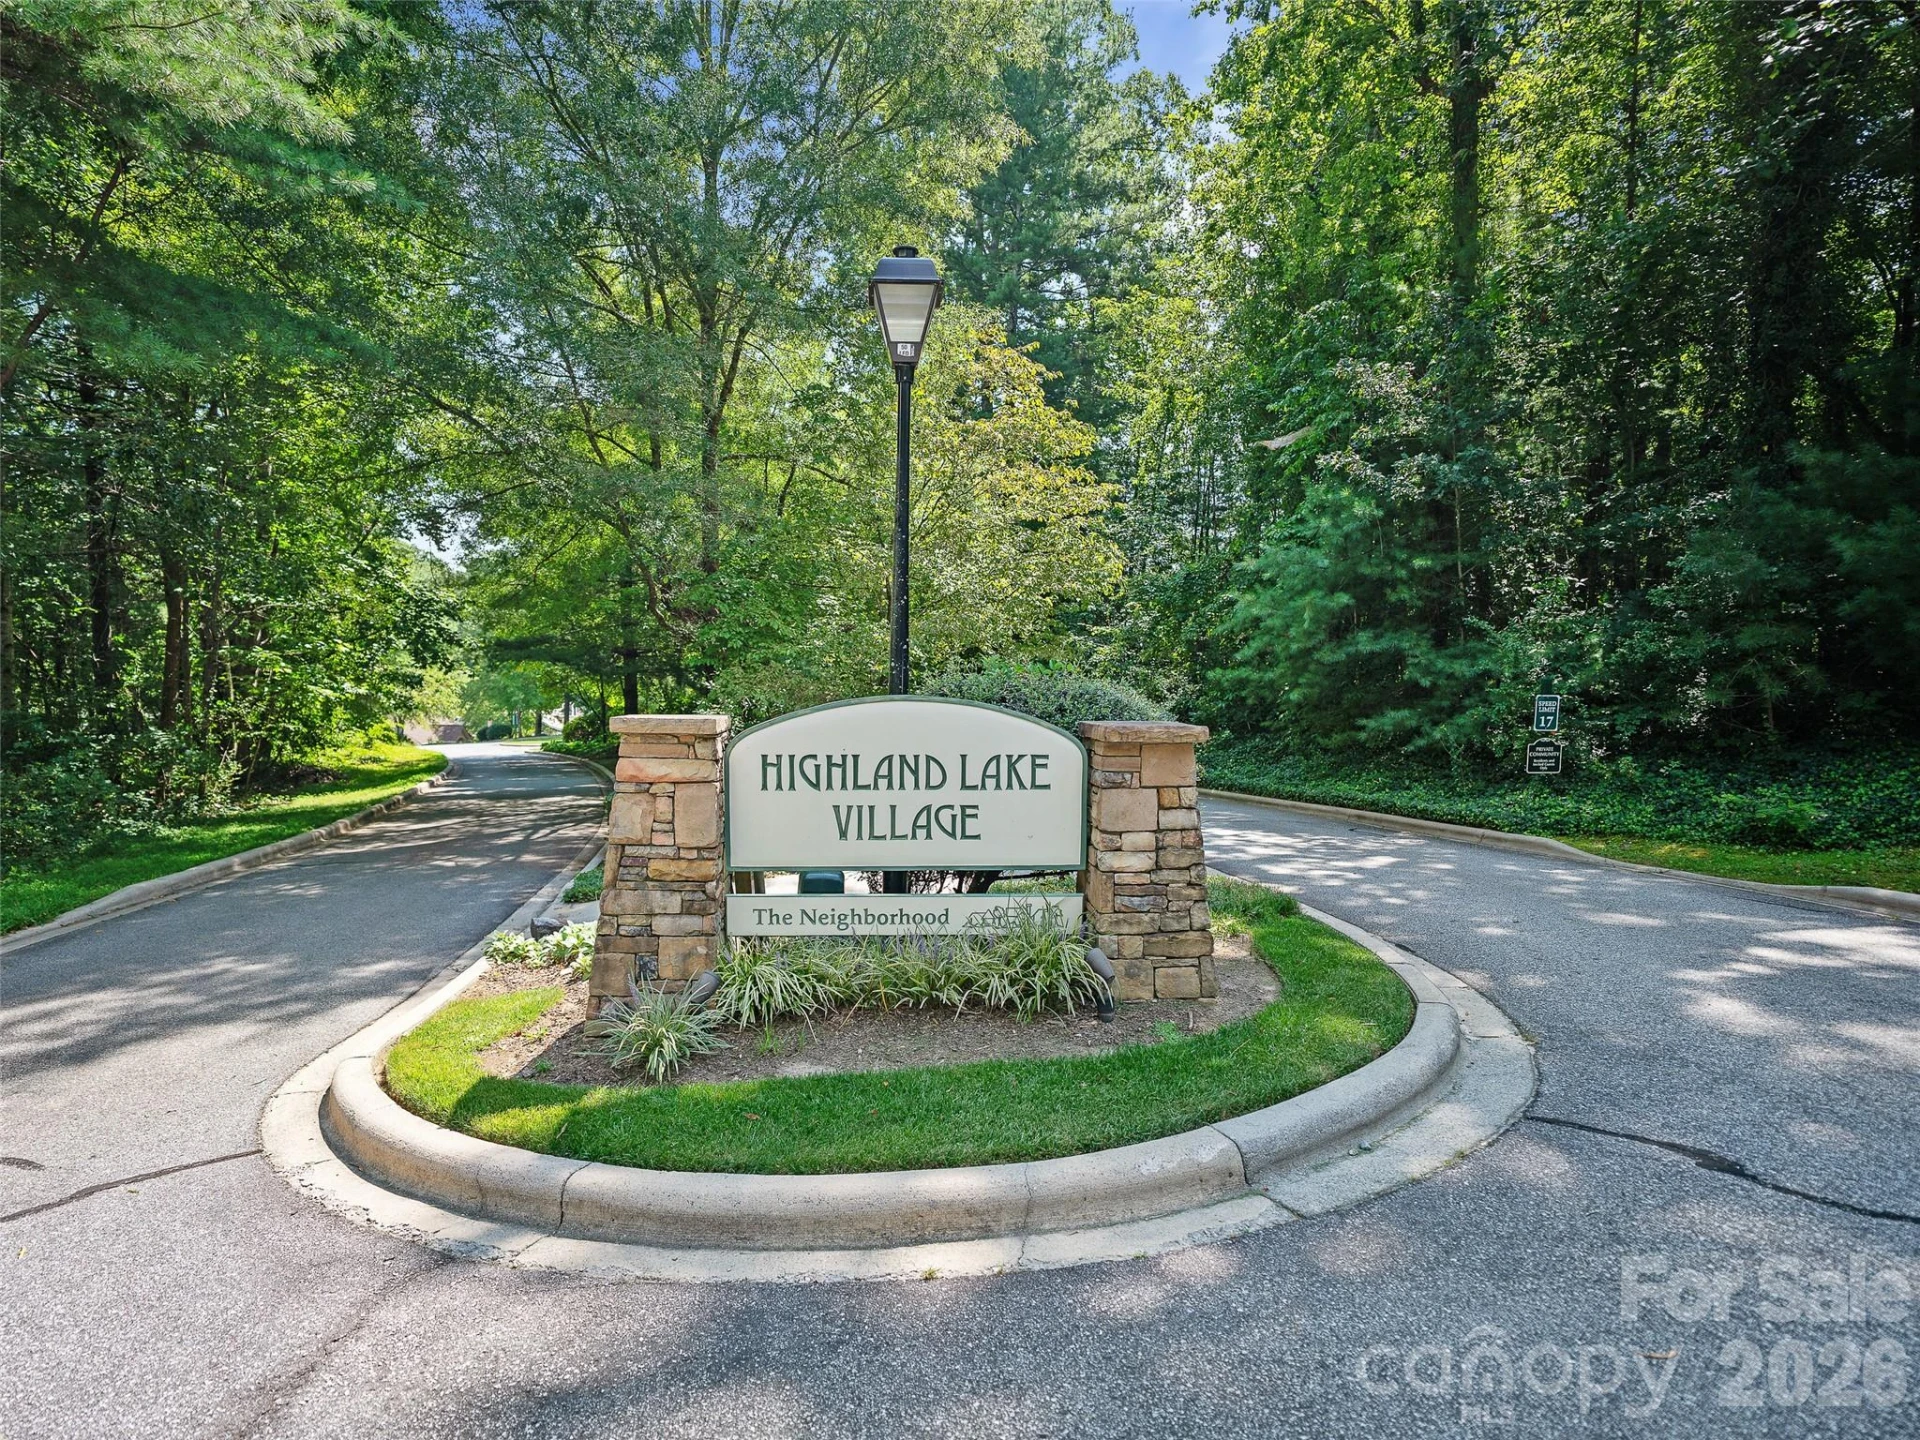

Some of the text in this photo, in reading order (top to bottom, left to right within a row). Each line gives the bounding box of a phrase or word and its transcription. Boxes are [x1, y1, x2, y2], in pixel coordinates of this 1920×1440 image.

[1539, 715, 1554, 728] 17
[760, 753, 1052, 791] HIGHLAND LAKE
[832, 803, 982, 841] VILLAGE
[752, 908, 949, 931] The Neighborhood
